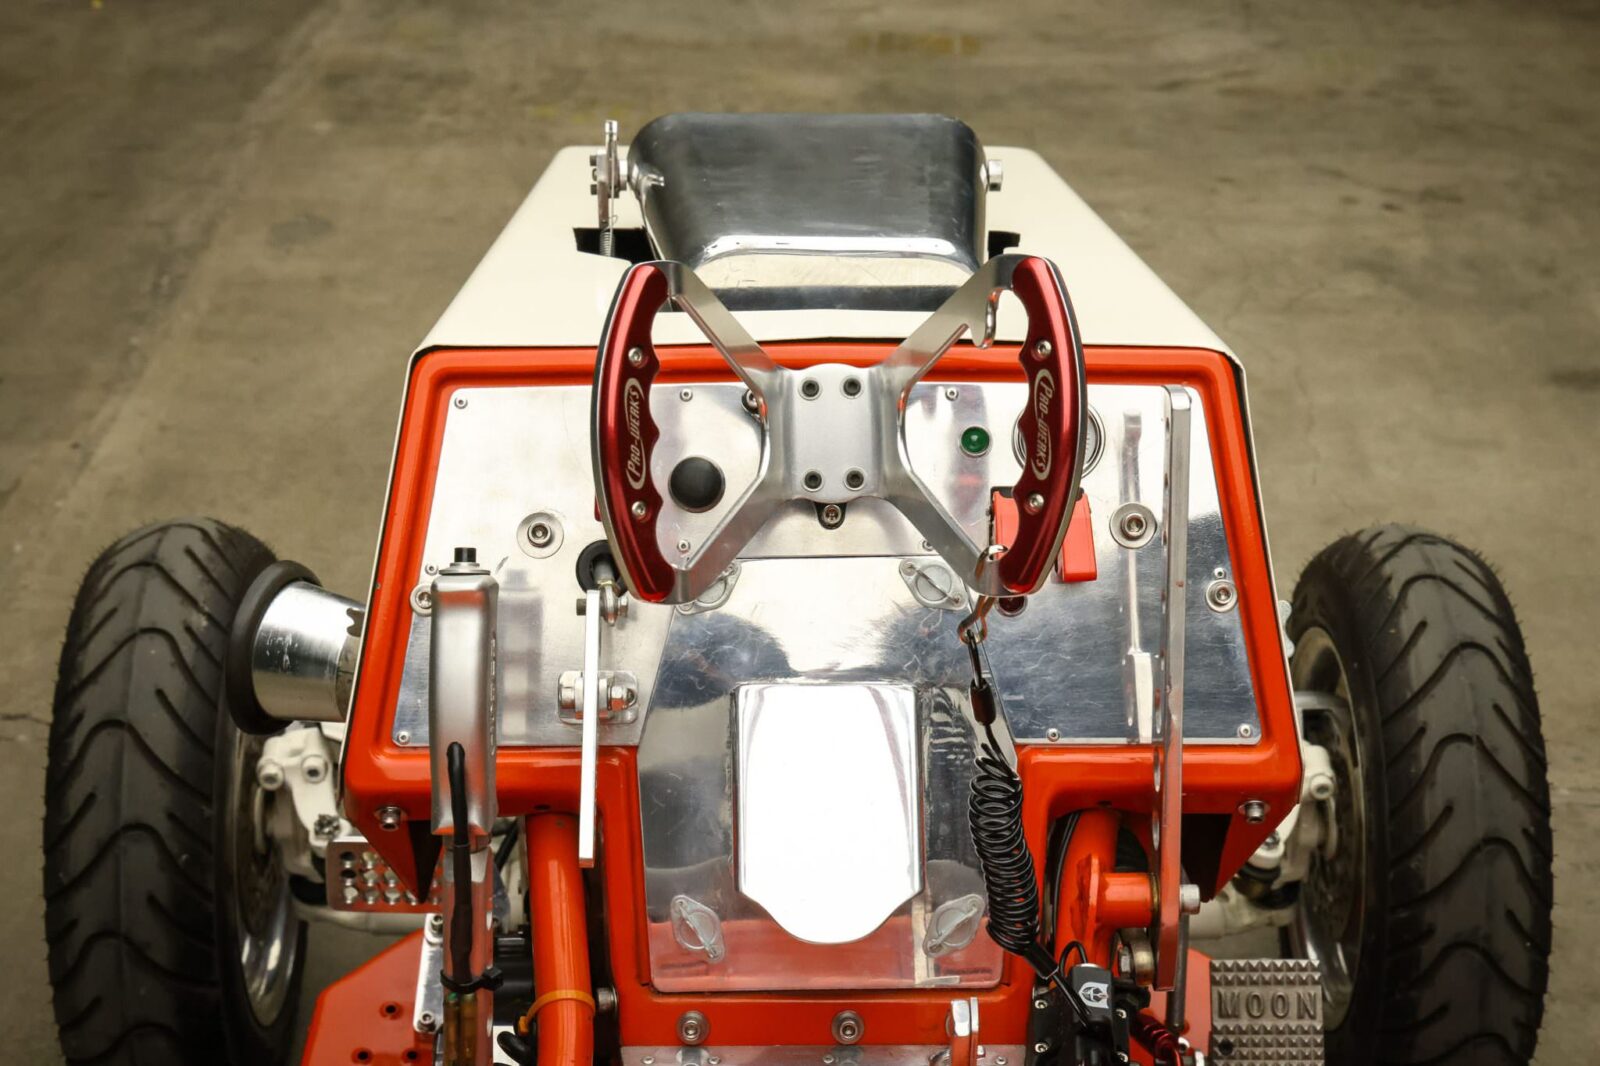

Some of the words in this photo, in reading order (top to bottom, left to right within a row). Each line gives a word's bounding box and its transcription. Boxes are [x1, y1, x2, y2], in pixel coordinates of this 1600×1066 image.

[627, 386, 641, 477] PRO-WERKS
[1036, 380, 1053, 472] PRO-WERKS
[1217, 990, 1317, 1020] MOON
